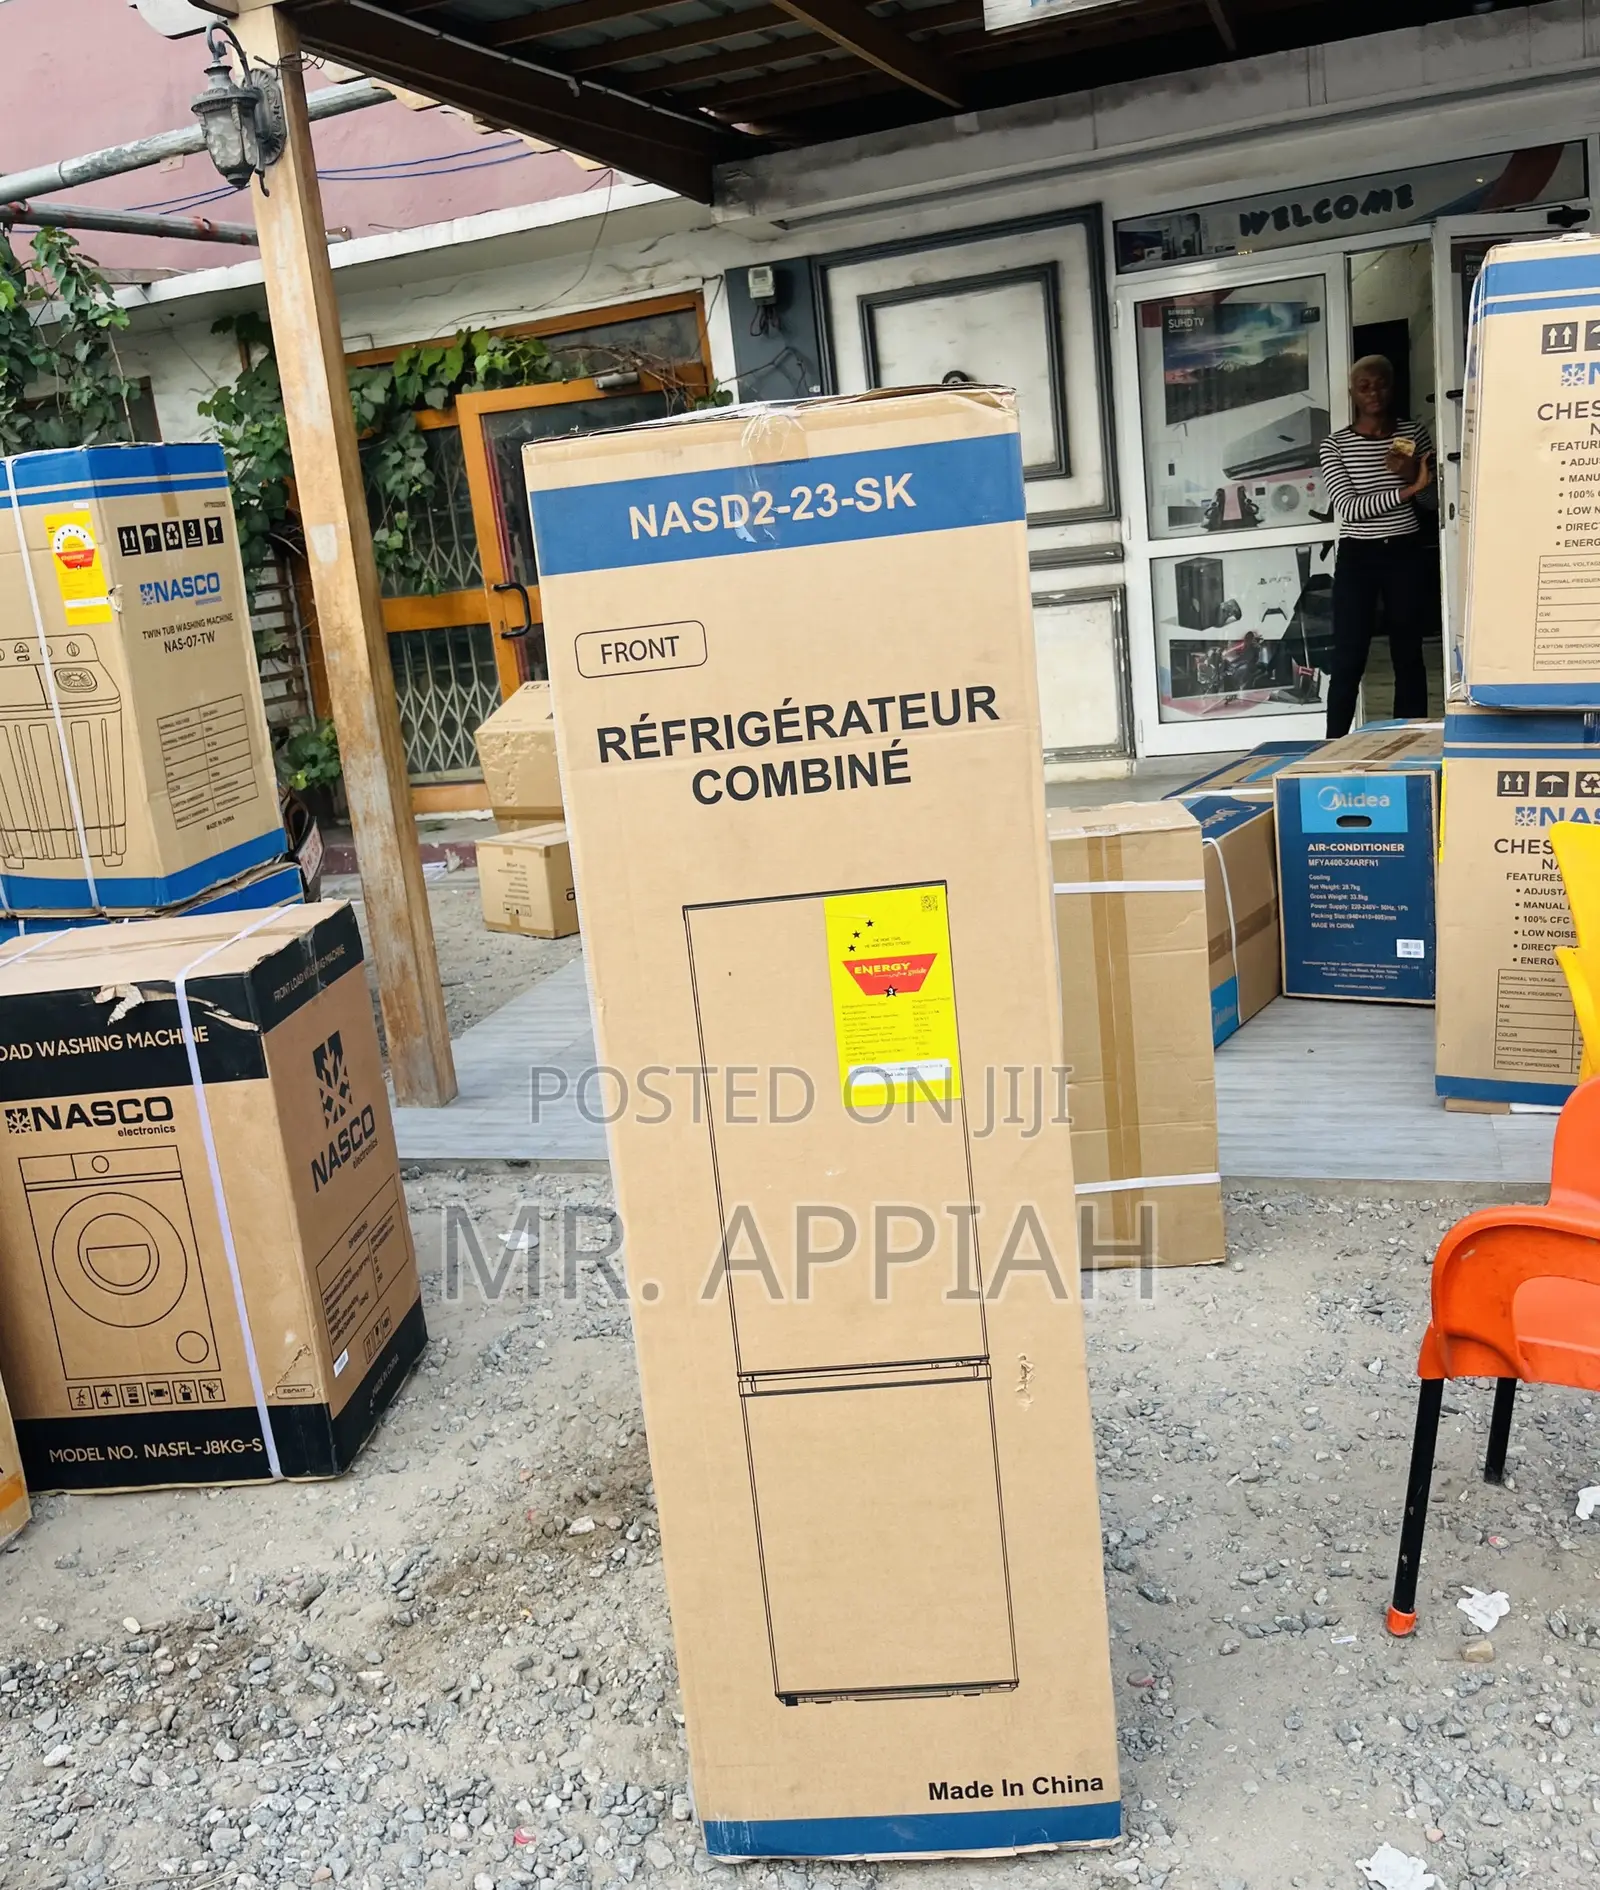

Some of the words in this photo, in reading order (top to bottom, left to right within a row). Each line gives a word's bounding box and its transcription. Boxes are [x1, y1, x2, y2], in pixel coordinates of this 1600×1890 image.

[1239, 183, 1414, 238] WELCOME
[1168, 318, 1192, 329] SUHD
[1194, 318, 1204, 327] TV
[1550, 440, 1600, 452] FEATUR
[1569, 458, 1600, 466] ADJU
[1568, 490, 1594, 499] 100%
[628, 473, 917, 540] NASD2-23-SK
[1566, 506, 1592, 515] LOW
[1566, 522, 1600, 532] DIREC
[154, 572, 221, 604] NASCO
[142, 631, 162, 640] TWIN
[162, 625, 176, 636] TUB
[175, 619, 206, 633] WASHING
[206, 613, 234, 625] MACHINE
[164, 631, 216, 654] NAS-07-TW
[600, 636, 680, 664] FRONT
[596, 684, 1000, 763] RÉFRIGÉRATEUR
[692, 738, 912, 805] COMBINÉ
[1325, 788, 1390, 809] Midea
[1308, 843, 1405, 852] AIR-CONDITIONER
[1494, 838, 1554, 854] CHES
[1542, 858, 1560, 870] N
[1523, 902, 1565, 910] MANUAL
[1524, 915, 1547, 923] 100%
[1550, 916, 1570, 924] CFC
[1522, 929, 1544, 937] LOW
[1546, 930, 1576, 938] NOISE
[854, 962, 911, 976] ENERGY
[36, 1034, 123, 1058] WASHING
[126, 1026, 210, 1049] MACHINE
[30, 1096, 174, 1132] NASCO
[117, 1125, 176, 1137] electronics
[311, 1104, 376, 1193] NASCO
[352, 1137, 378, 1169] electronics
[50, 1448, 104, 1463] MODEL
[108, 1446, 138, 1460] NO.
[144, 1437, 264, 1458] NASFL-J8KG-S
[928, 1781, 994, 1800] Made
[1002, 1779, 1024, 1797] In
[1032, 1775, 1104, 1795] China
